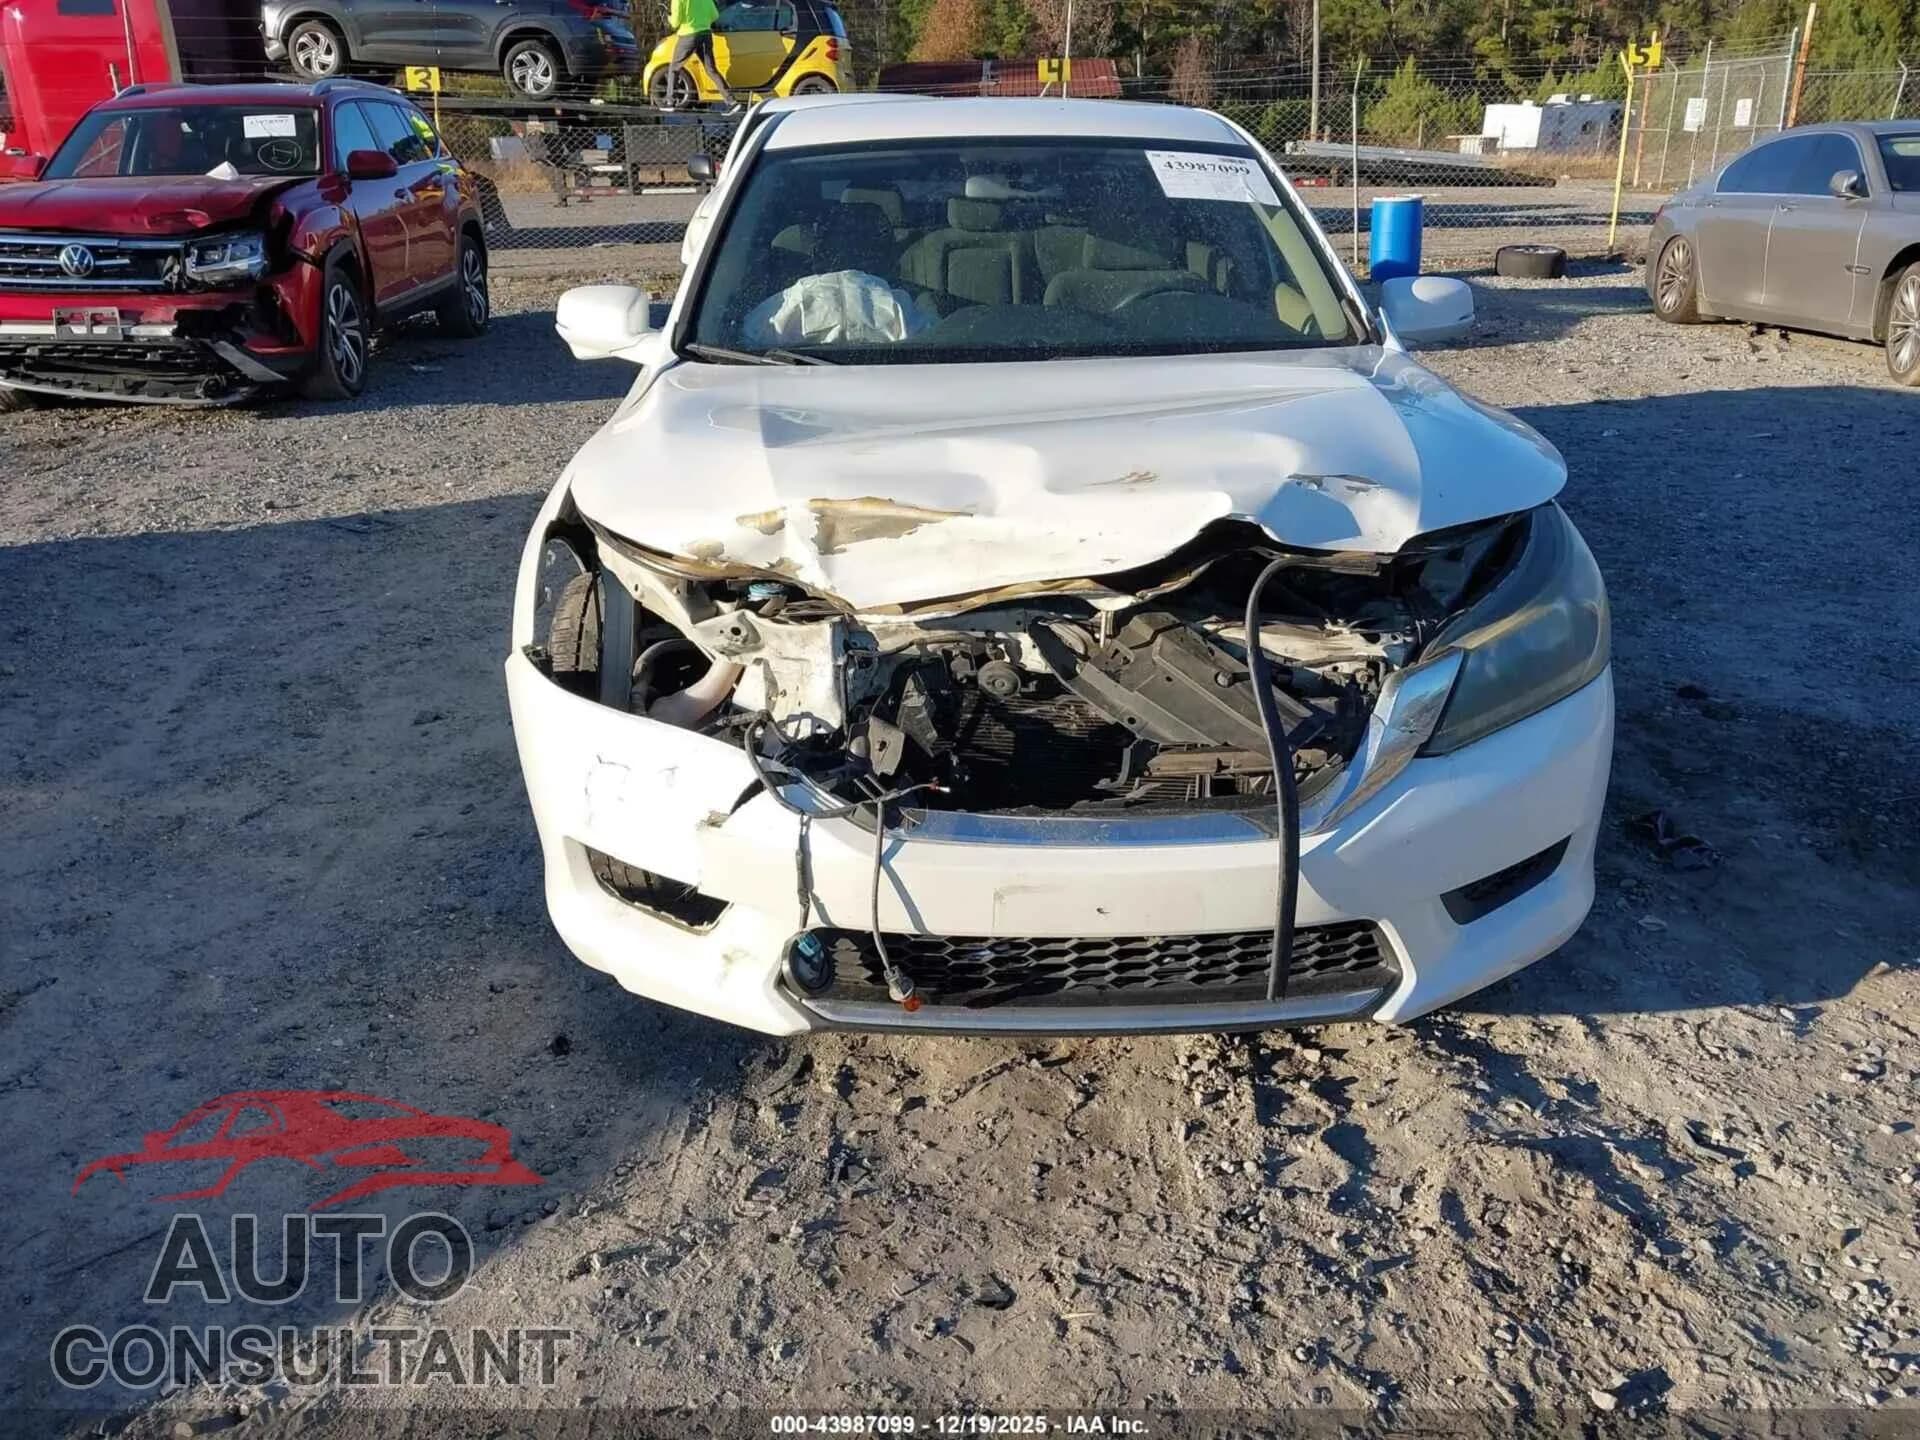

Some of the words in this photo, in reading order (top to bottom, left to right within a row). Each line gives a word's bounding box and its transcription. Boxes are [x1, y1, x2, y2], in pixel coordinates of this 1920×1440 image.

[1632, 43, 1650, 65] 5
[413, 68, 432, 90] 3
[1047, 58, 1063, 82] 4
[1163, 159, 1251, 175] 43987099
